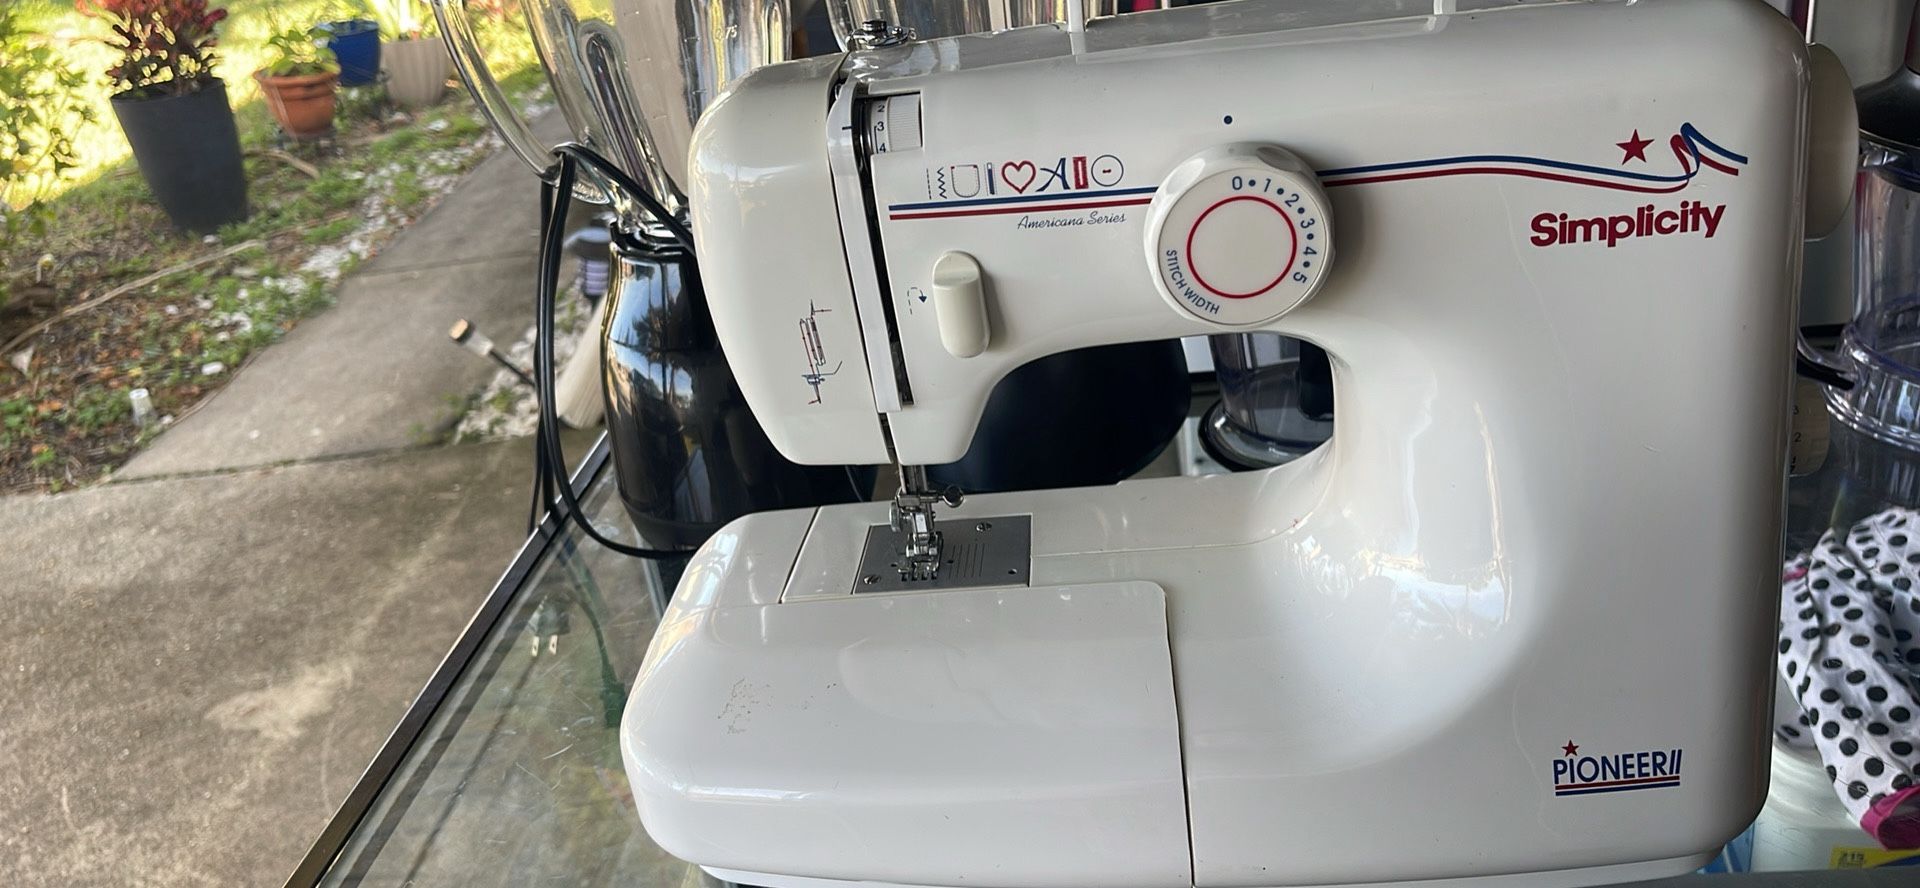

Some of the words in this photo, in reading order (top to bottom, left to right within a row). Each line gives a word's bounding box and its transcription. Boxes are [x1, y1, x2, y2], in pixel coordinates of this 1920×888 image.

[877, 121, 885, 131] 3
[879, 143, 886, 153] 4
[1232, 176, 1243, 190] 0
[1263, 178, 1271, 193] 1
[1285, 193, 1300, 207] 2
[1018, 215, 1084, 230] Americana
[1087, 210, 1127, 226] Series
[1300, 218, 1315, 229] 3
[1530, 200, 1727, 248] Simplicity
[1303, 246, 1317, 257] 4
[1166, 249, 1185, 290] STITCH
[1184, 286, 1220, 315] WIDTH
[1293, 272, 1307, 285] 5
